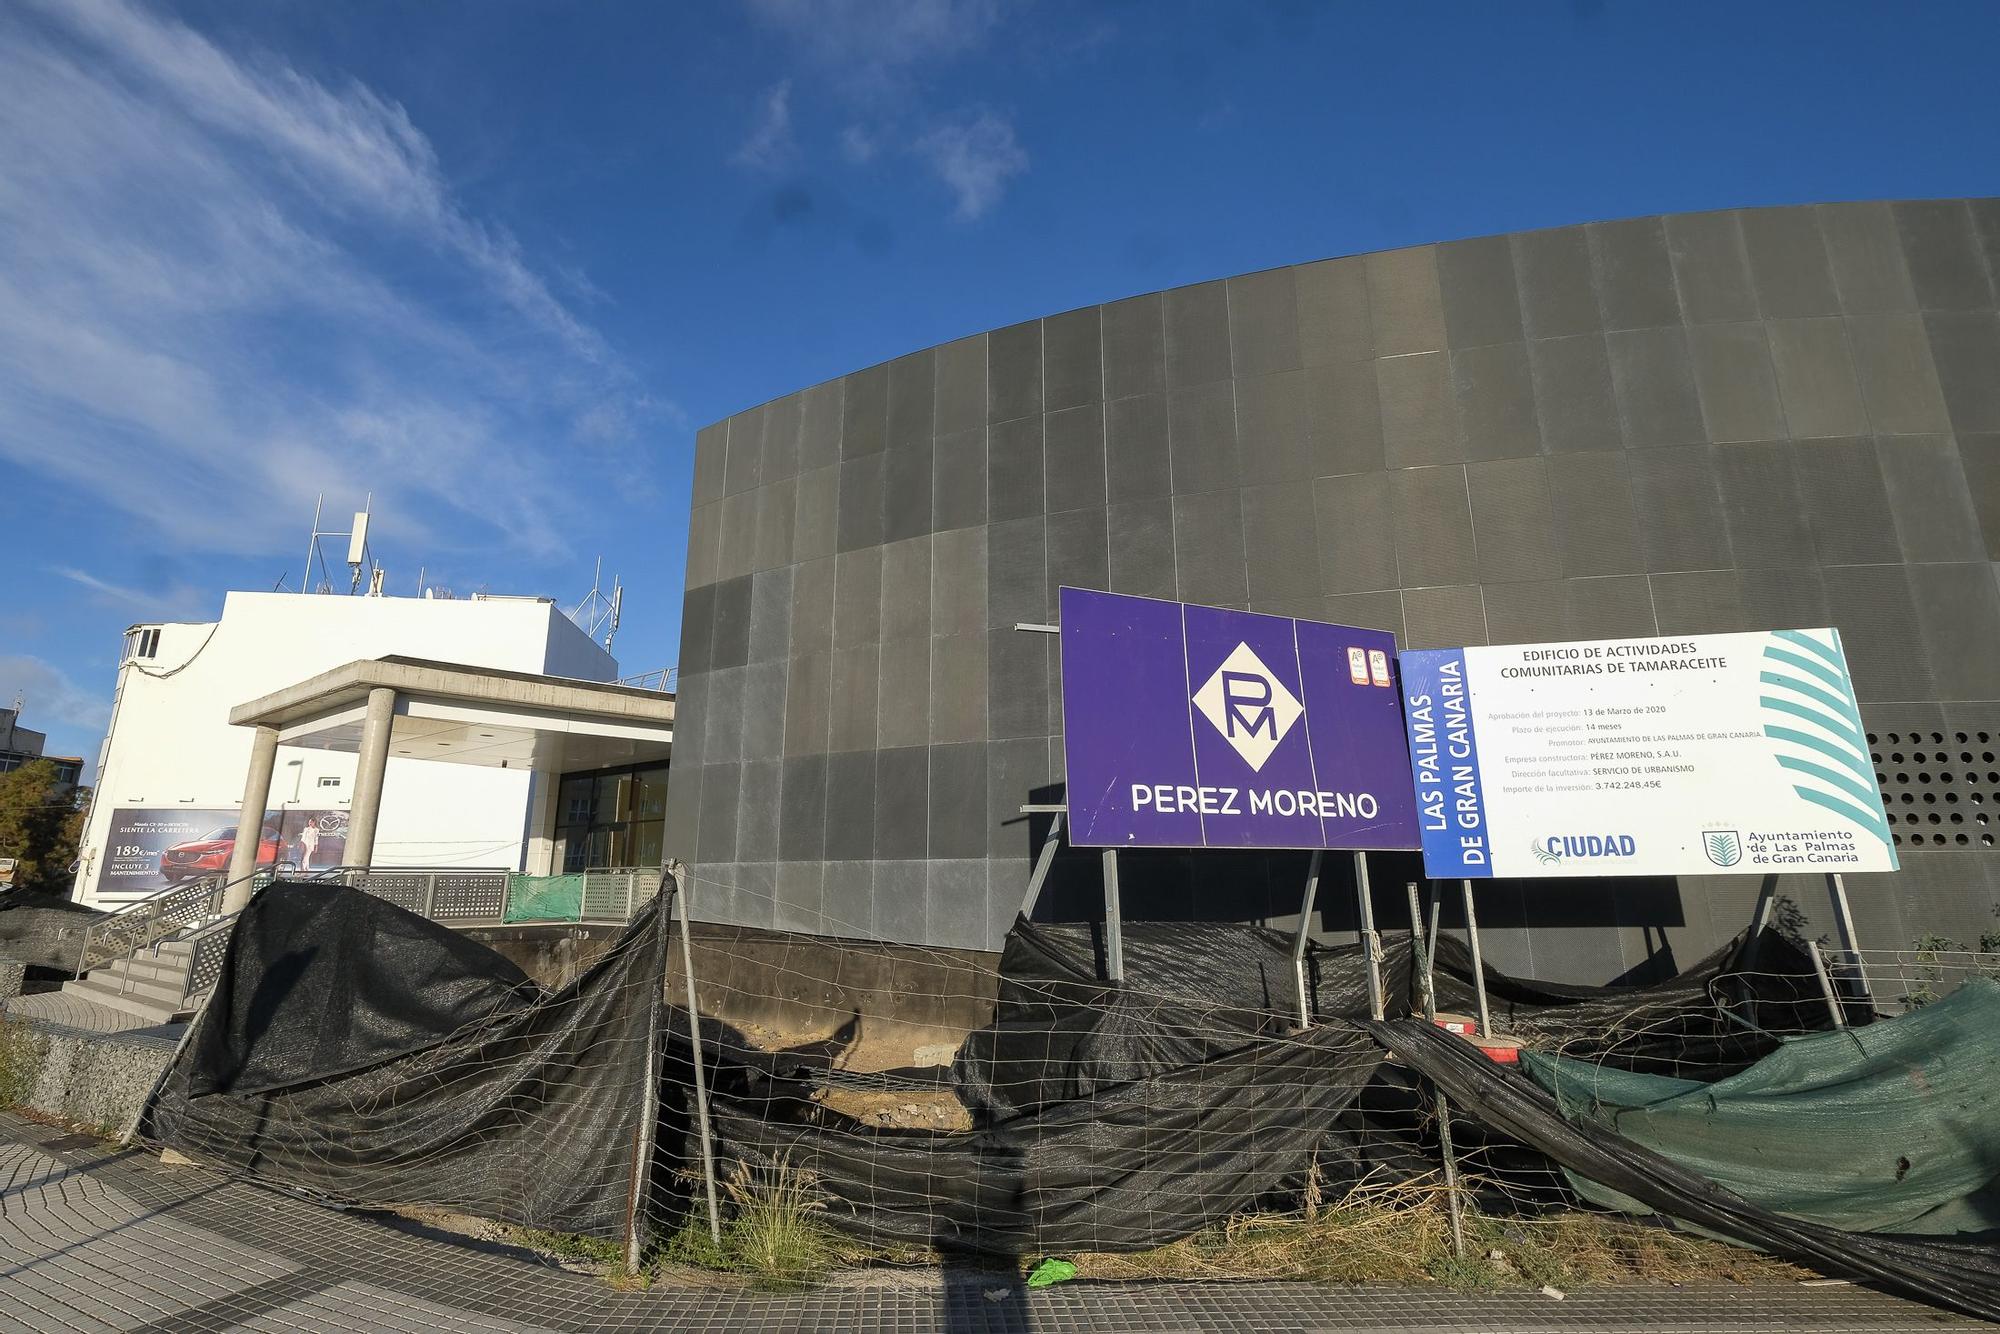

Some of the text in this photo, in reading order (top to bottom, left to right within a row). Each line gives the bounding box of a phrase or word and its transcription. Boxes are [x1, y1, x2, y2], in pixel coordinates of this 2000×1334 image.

[1523, 642, 1697, 661] EDIFICIO DE ACTIVIDADES
[1500, 657, 1727, 679] COMUNITARIAS DE TAMARACEITE
[1488, 704, 1667, 721] Aprobación del proyecto: 13 de Marzo de 2020
[1512, 726, 1532, 734] Plazo
[1533, 725, 1543, 733] de
[1586, 723, 1596, 731] 14
[1597, 723, 1622, 731] meses
[1548, 739, 1586, 748] Promotor:
[1588, 736, 1641, 745] AYUNTAMIENTO
[1667, 733, 1695, 742] PALMAS
[1696, 733, 1706, 741] DE
[1707, 732, 1728, 740] GRAN
[1409, 694, 1447, 831] LAS PALMAS
[1439, 660, 1485, 865] DE GRAN CANARIA
[1504, 749, 1682, 764] Empresa constructora: PÉREZ MORENO, S.A.U.
[1511, 763, 1695, 779] Dirección facultativa: SERVICIO DE URBANISMO
[1503, 784, 1533, 795] Importe
[1534, 782, 1545, 792] de
[1546, 783, 1553, 791] la
[1131, 784, 1378, 819] PEREZ MORENO
[1749, 829, 1853, 843] Ayuntamiento
[1547, 835, 1636, 857] CIUDAD
[1750, 841, 1855, 852] de Las Palmas
[1752, 851, 1859, 864] de Gran Canaria
